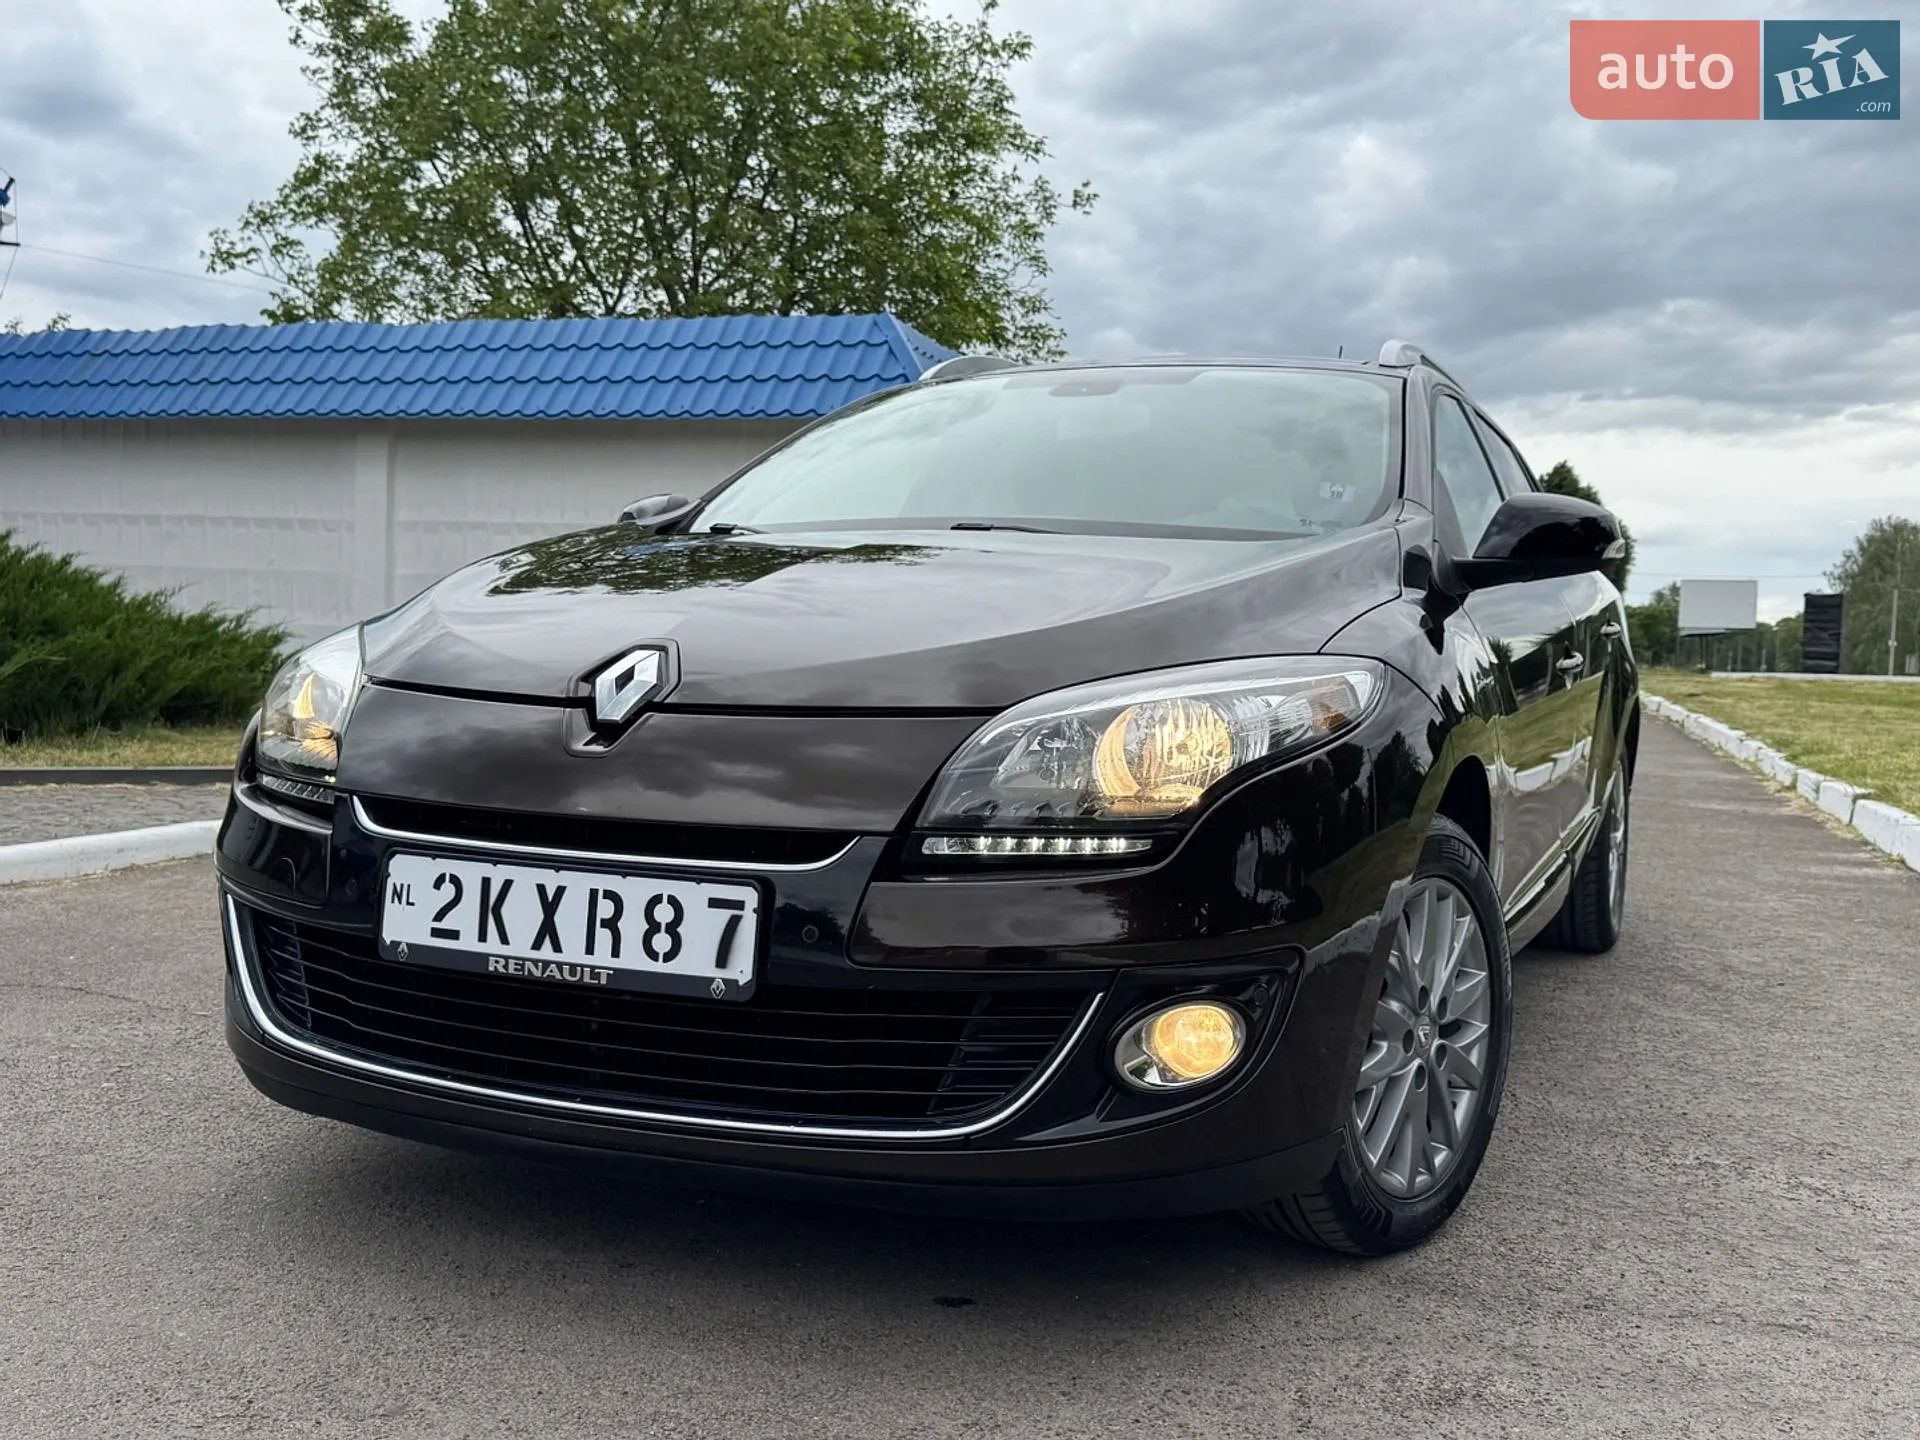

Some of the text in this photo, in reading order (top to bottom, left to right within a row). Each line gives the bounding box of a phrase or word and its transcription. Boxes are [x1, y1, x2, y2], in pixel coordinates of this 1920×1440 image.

[391, 872, 746, 969] NL 2KXR87
[488, 957, 614, 985] RENAULT
